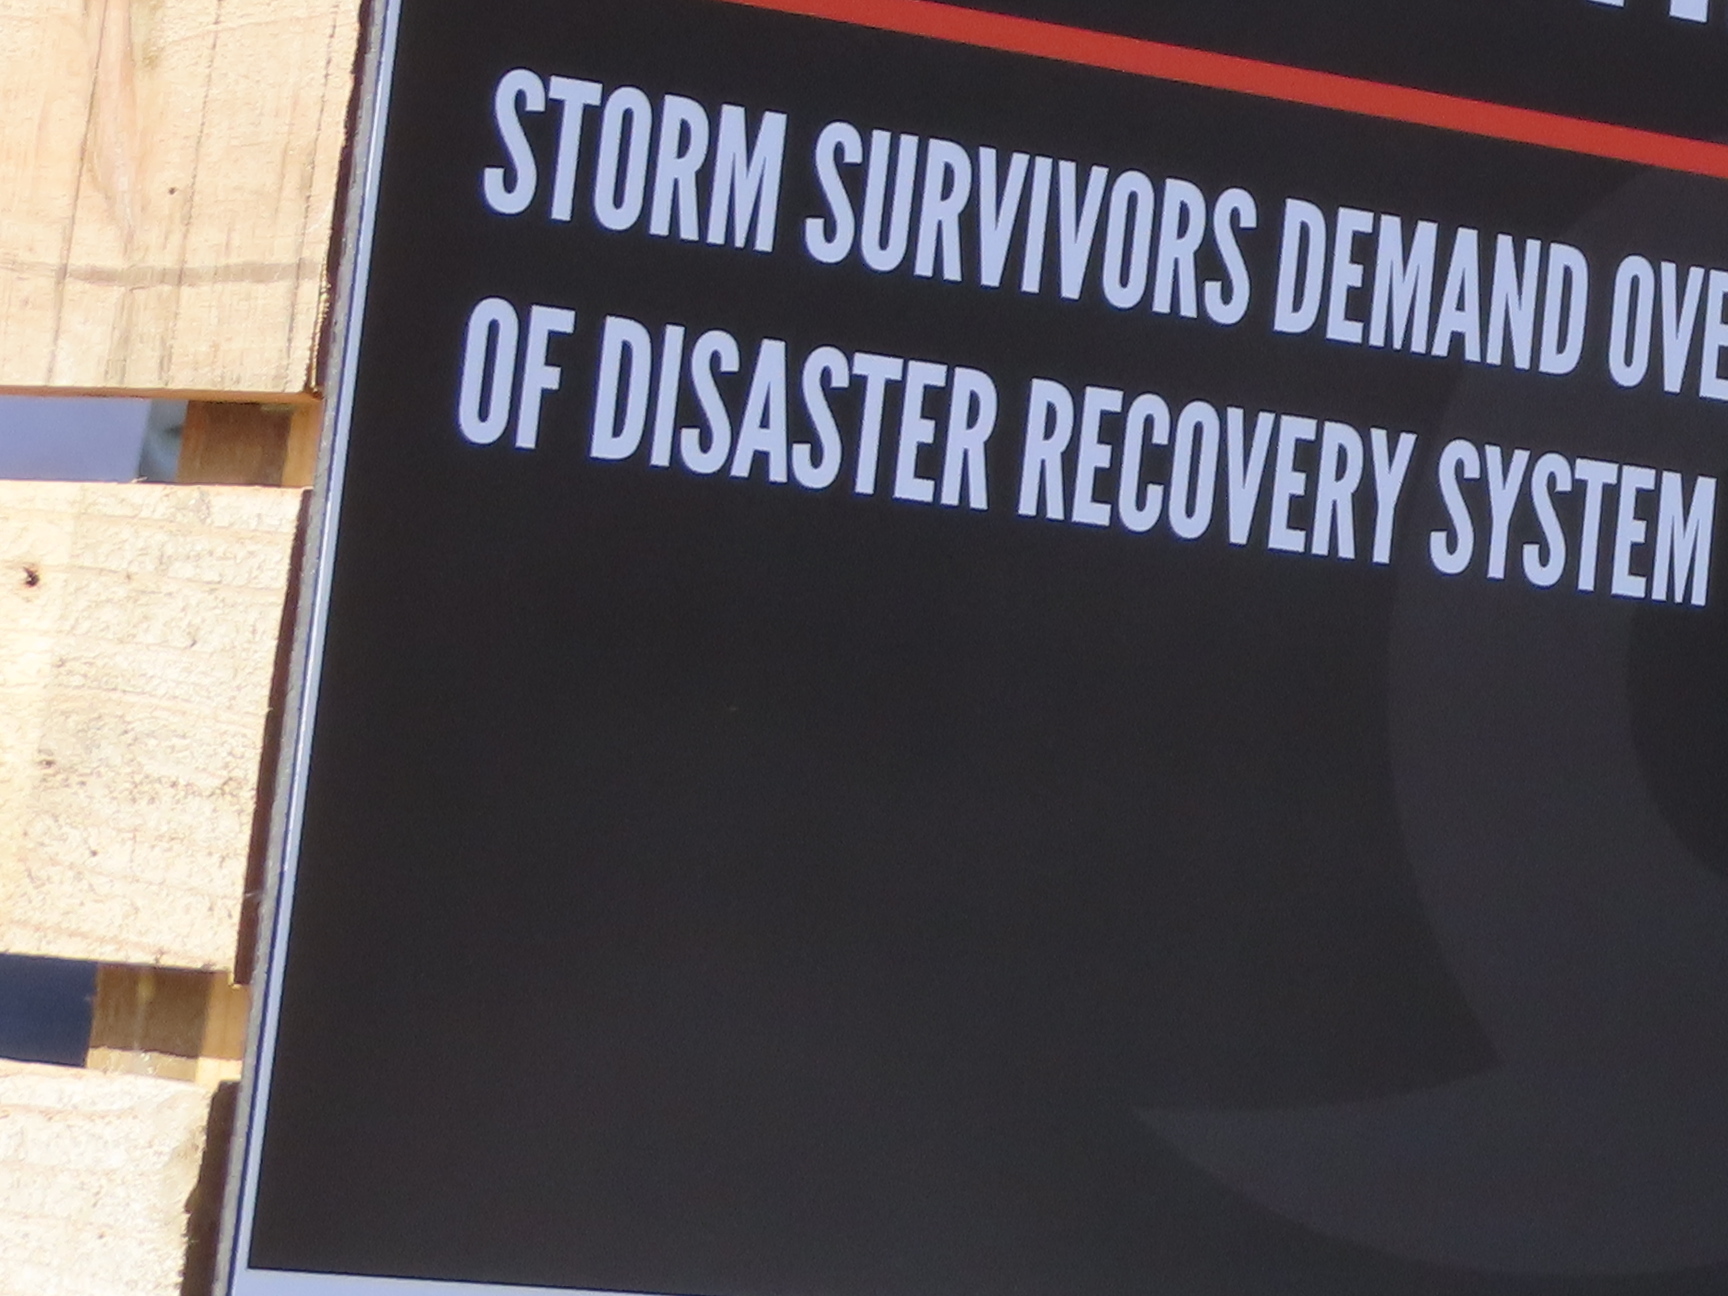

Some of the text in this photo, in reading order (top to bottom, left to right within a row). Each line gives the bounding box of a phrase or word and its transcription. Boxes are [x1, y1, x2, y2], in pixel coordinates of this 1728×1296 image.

[483, 69, 787, 253] STORM
[806, 121, 1257, 325] SURVIVORS
[1274, 198, 1589, 375] DEMAND
[458, 297, 1717, 607] OF DISASTER RECOVERY SYSTEM
